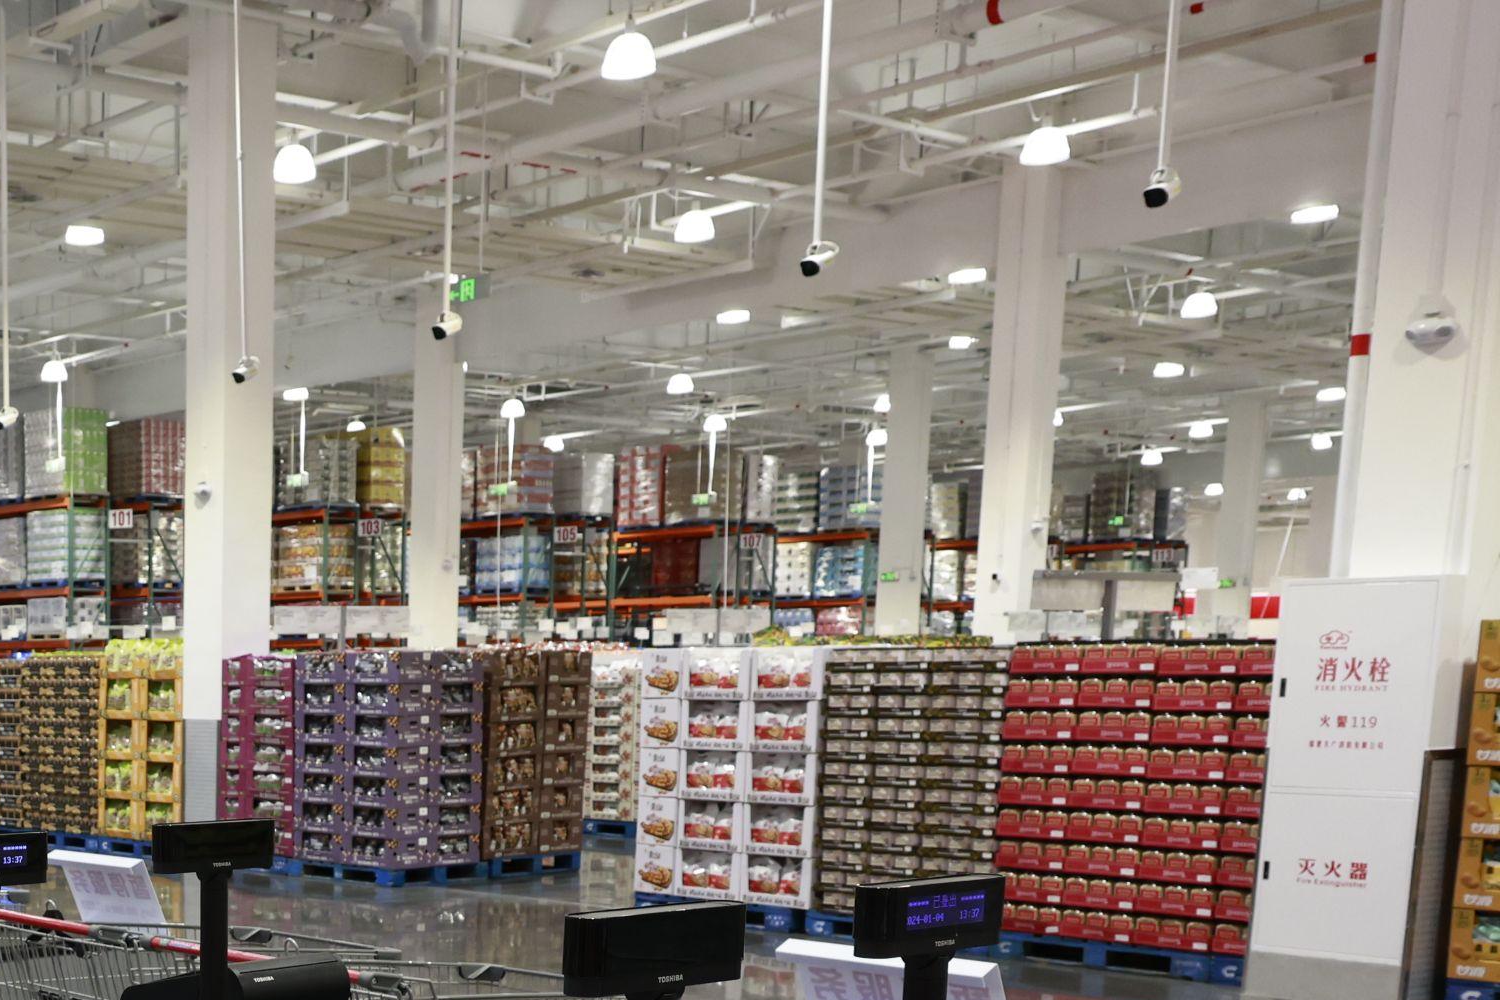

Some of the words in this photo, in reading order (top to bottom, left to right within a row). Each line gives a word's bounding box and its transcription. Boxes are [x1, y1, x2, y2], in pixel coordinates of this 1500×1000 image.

[112, 511, 131, 526] 101
[361, 520, 380, 535] 103
[556, 527, 577, 541] 105
[743, 534, 761, 547] 107
[1316, 657, 1391, 682] 消火栓
[3, 855, 23, 865] 13:37
[212, 860, 232, 868] TOSHIBA
[1298, 858, 1368, 880] 灭火器
[960, 907, 980, 920] 13:37
[934, 938, 956, 948] TOSHIBA
[253, 976, 275, 984] TOSHIBA
[657, 973, 684, 984] TOSHIBA
